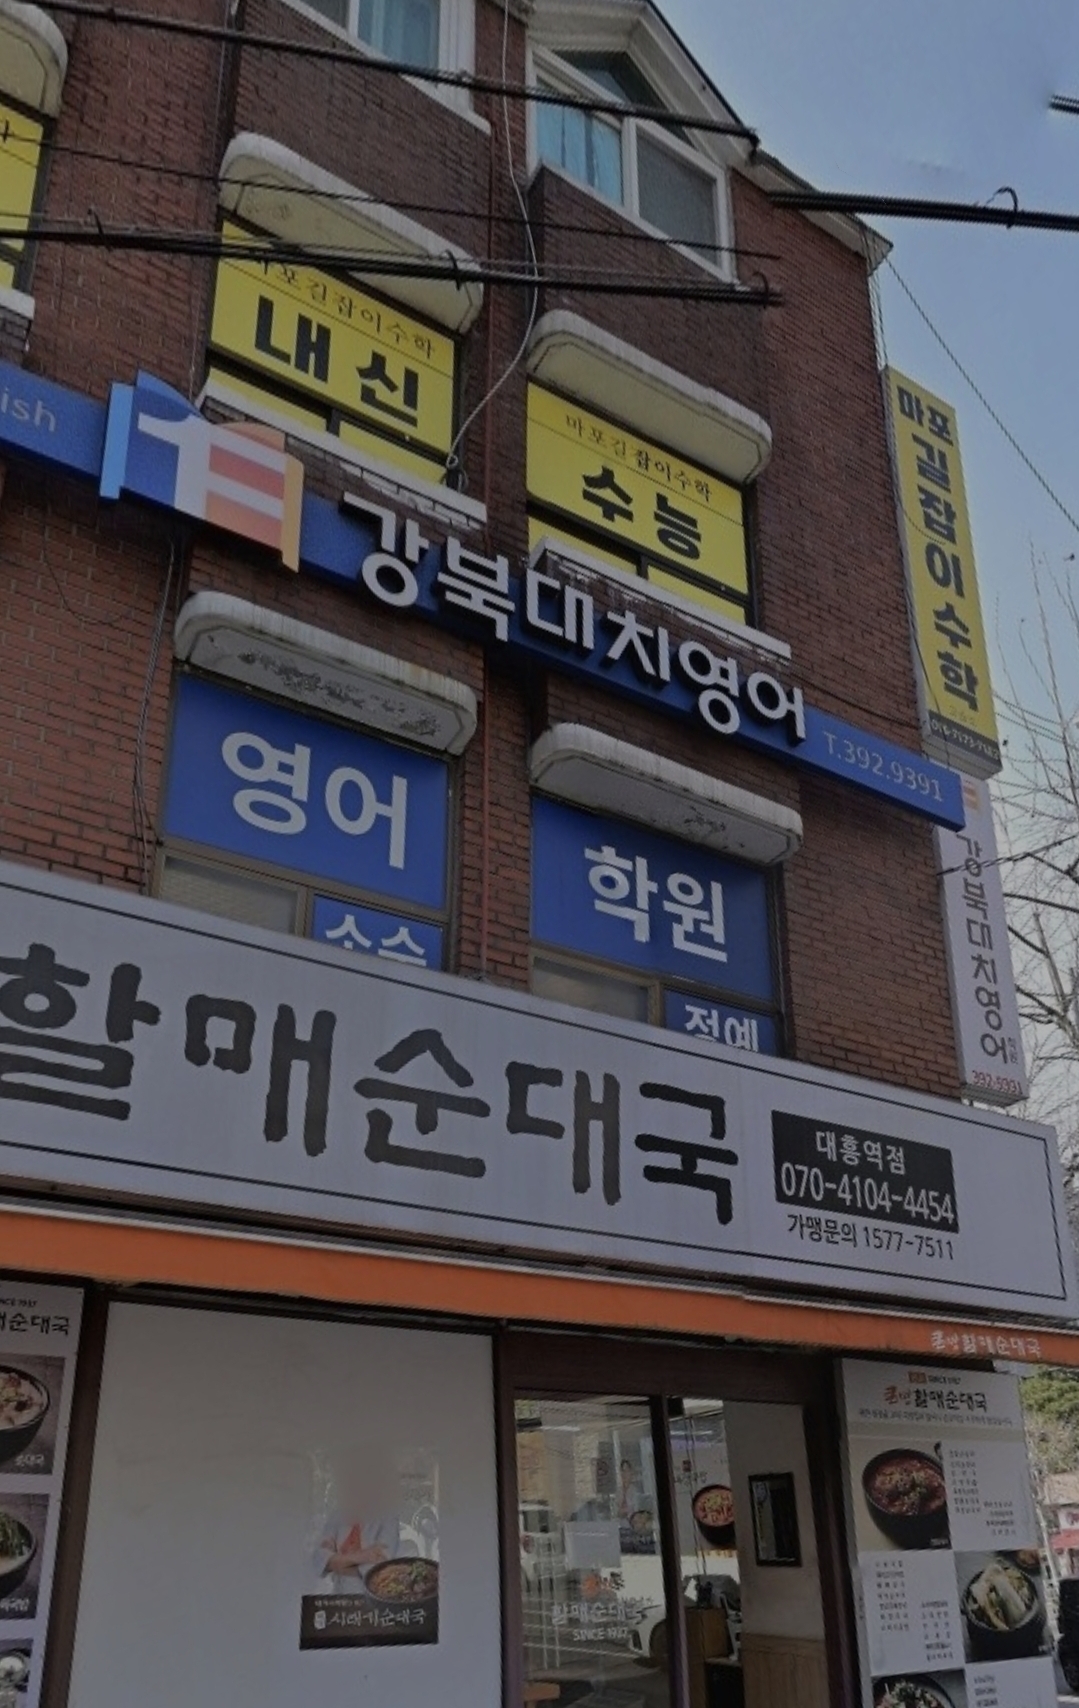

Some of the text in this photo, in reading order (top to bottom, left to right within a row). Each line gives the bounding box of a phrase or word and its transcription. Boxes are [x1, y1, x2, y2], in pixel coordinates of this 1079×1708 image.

[254, 295, 419, 428] 내신
[581, 465, 702, 561] 수능
[342, 491, 806, 742] 강북대치영어
[221, 731, 408, 870] 영어
[822, 730, 944, 802] T.392.9391
[584, 844, 729, 964] 학원
[0, 942, 740, 1226] 할매순대국
[780, 1161, 955, 1225] 070-4104-4454
[815, 1130, 906, 1176] 대흥역점
[787, 1213, 954, 1261] 가맹문의 1577-7511
